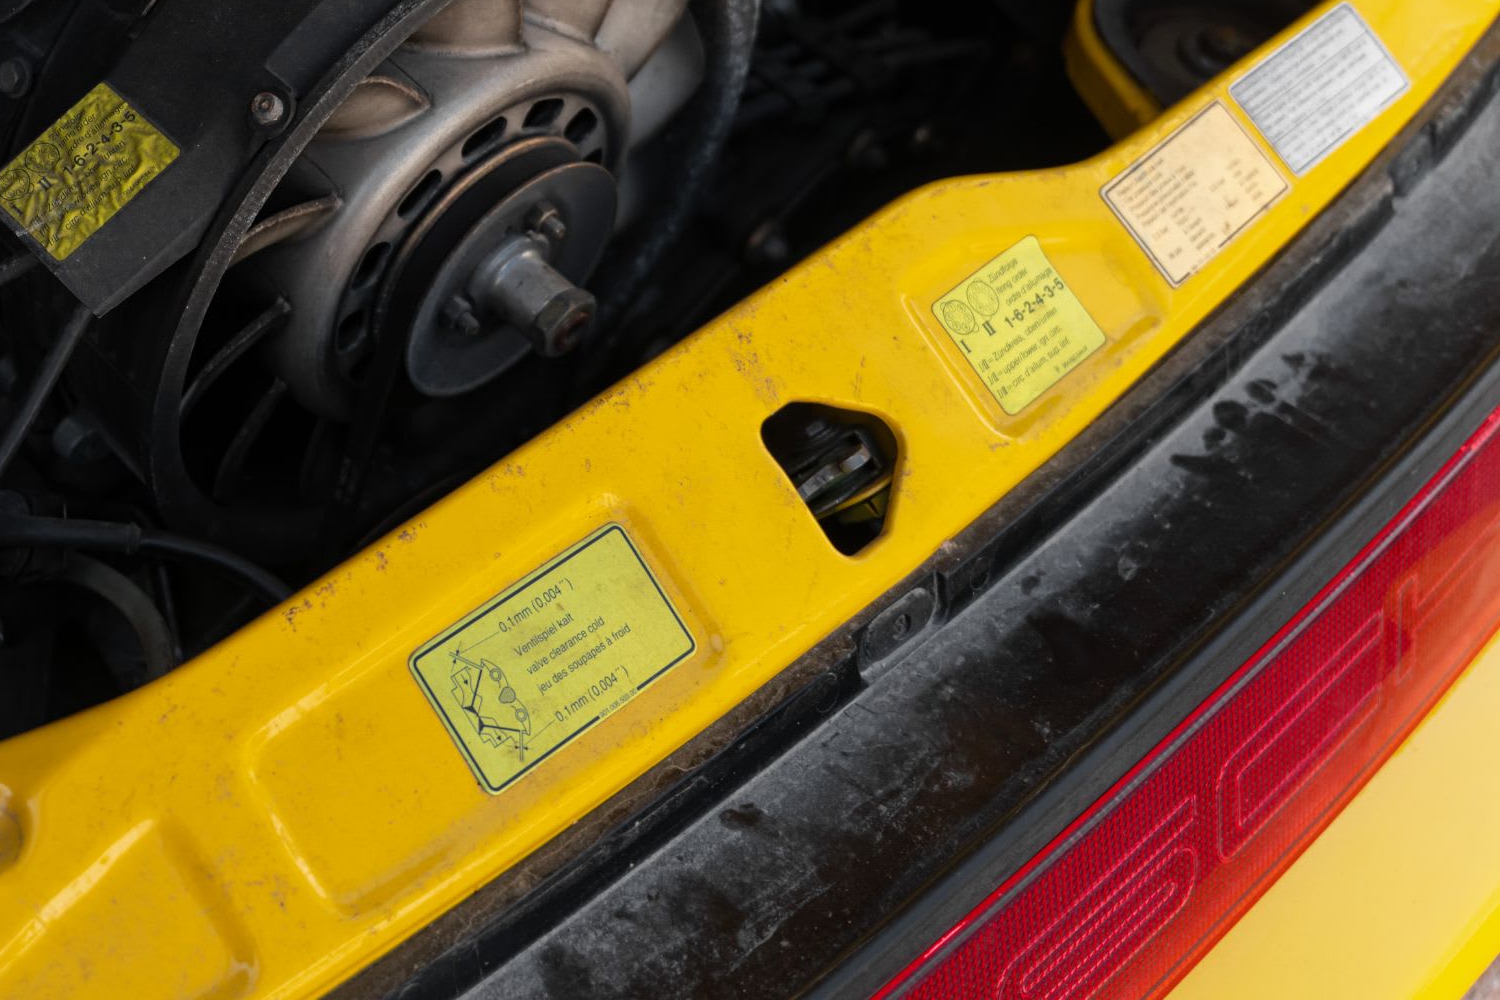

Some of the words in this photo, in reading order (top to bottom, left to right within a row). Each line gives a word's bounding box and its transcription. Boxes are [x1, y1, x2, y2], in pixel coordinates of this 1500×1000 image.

[63, 112, 136, 175] 1-6-2-4-3-5
[1004, 277, 1064, 329] 1-6-2-4-3-5
[959, 340, 971, 354] I
[981, 322, 996, 336] II
[499, 606, 533, 633] 0,1mm
[514, 624, 557, 656] Ventilspiel
[557, 613, 574, 628] kalt
[526, 656, 549, 675] valve
[549, 631, 587, 659] clearance
[587, 616, 605, 633] cold
[538, 680, 553, 696] jeu
[552, 670, 568, 684] des
[568, 643, 606, 673] soupapes
[605, 637, 614, 647] à
[612, 624, 631, 641] froid
[555, 695, 589, 722] 0,1mm
